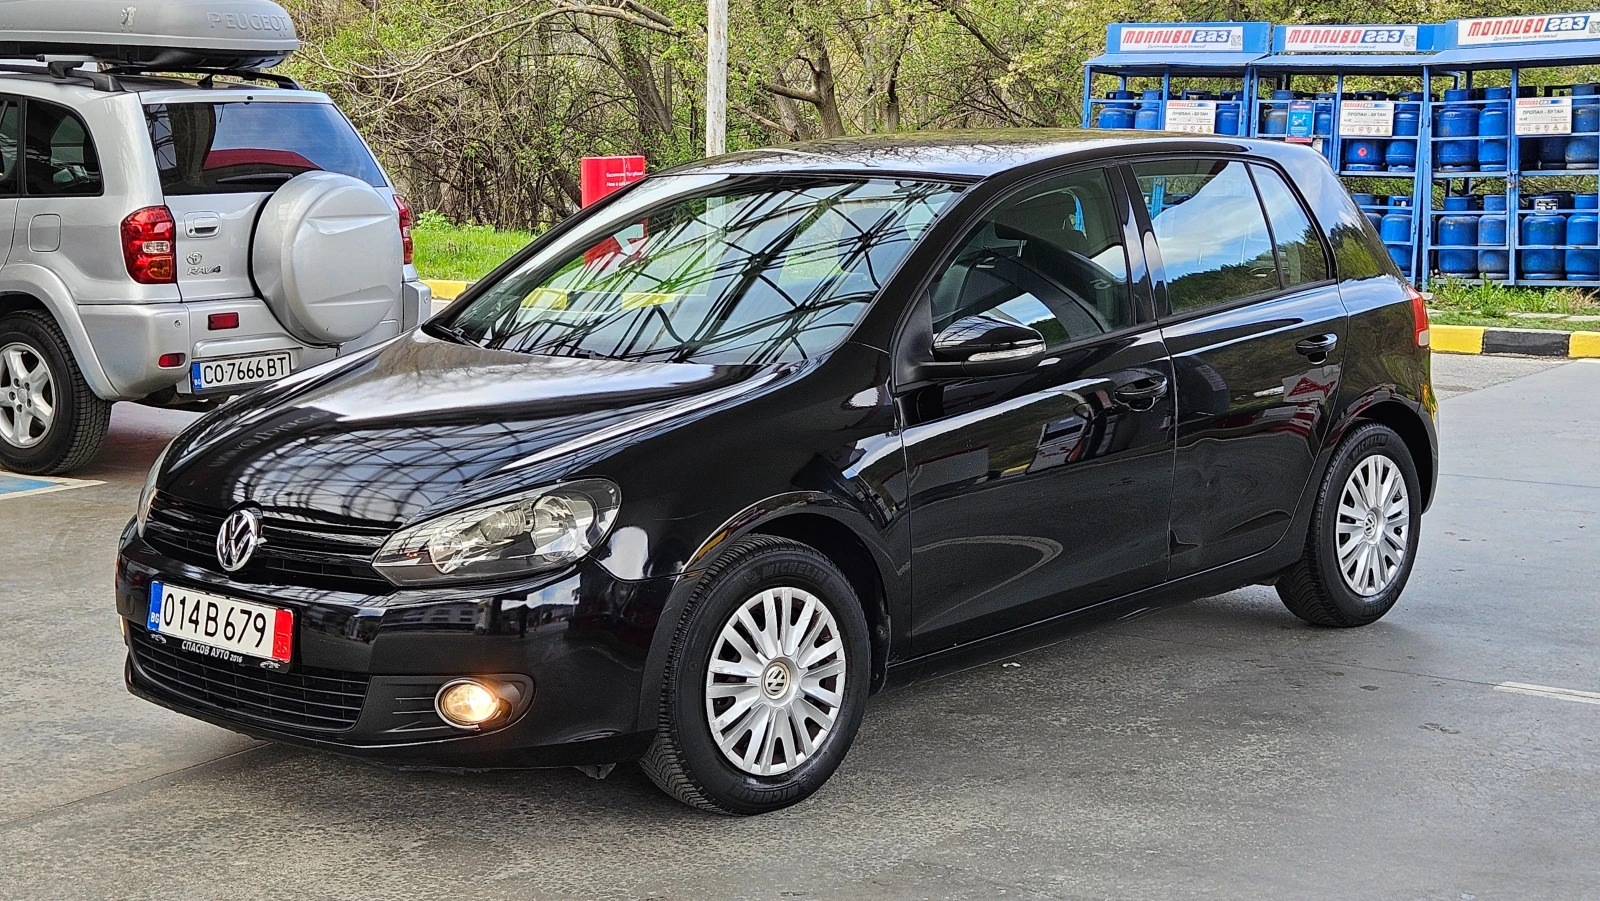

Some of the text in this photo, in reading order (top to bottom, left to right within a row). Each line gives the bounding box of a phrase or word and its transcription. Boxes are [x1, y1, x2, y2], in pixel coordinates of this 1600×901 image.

[207, 11, 288, 31] PEUGEOT
[187, 264, 222, 276] RAV4
[762, 562, 827, 582] MICHELIN
[150, 612, 160, 624] BG
[181, 640, 243, 663] СПАСОВ АУТО 2016
